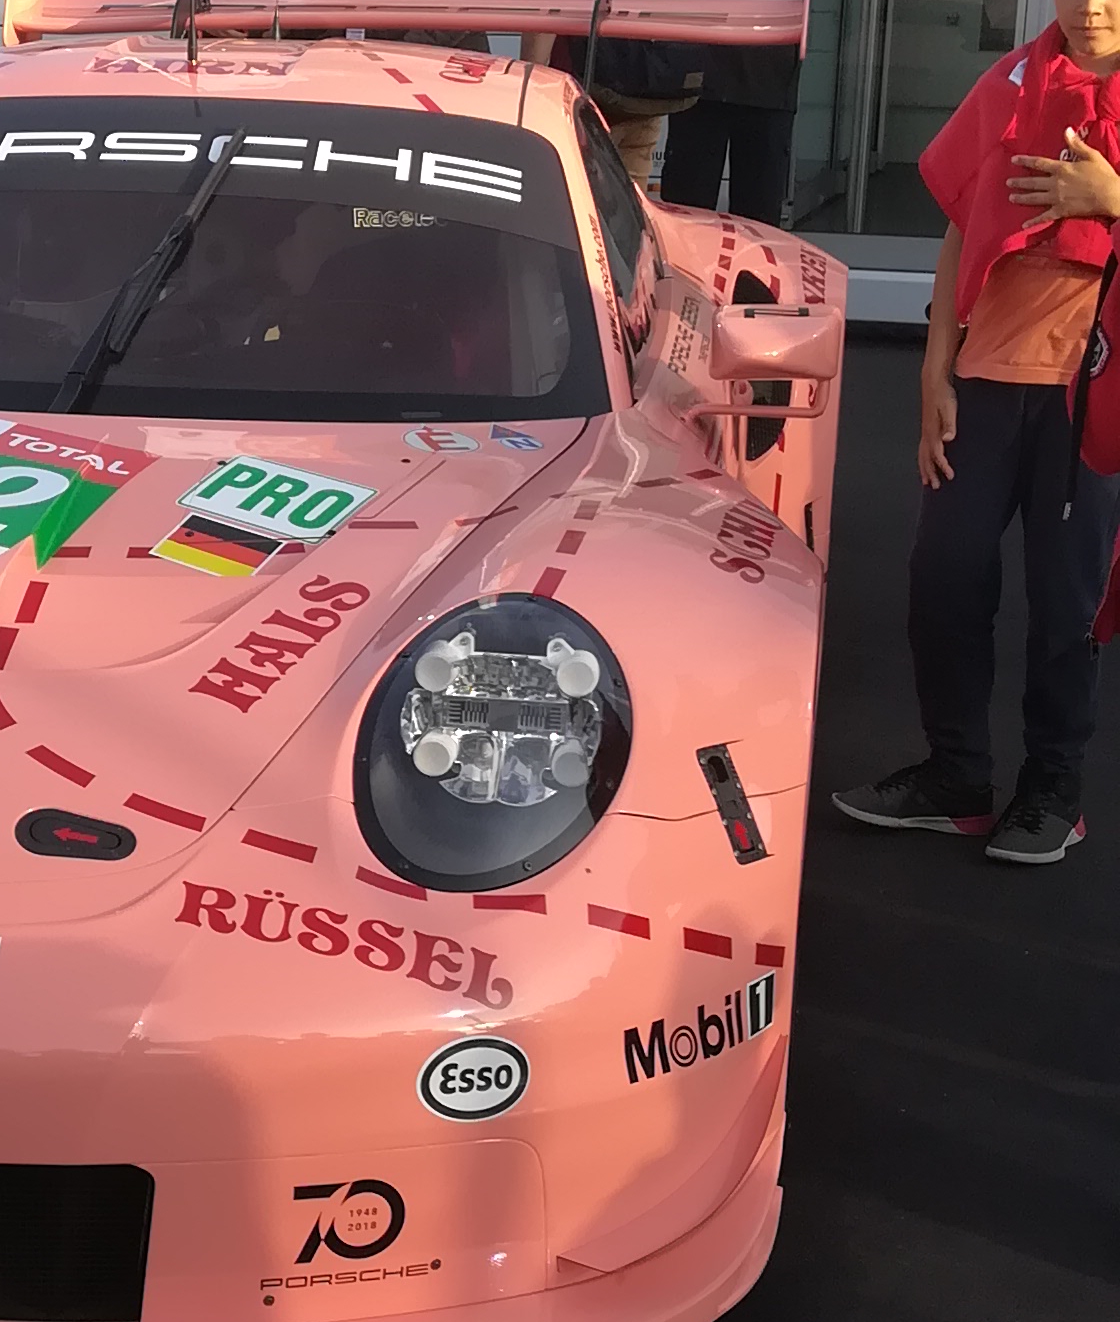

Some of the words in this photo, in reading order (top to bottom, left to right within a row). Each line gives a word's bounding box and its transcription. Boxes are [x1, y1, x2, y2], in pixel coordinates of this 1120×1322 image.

[6, 432, 130, 476] TOTAL
[195, 462, 356, 530] PRO
[189, 573, 372, 713] HALS
[174, 879, 515, 1011] RÜSSEL
[292, 1178, 406, 1265] 70
[347, 1220, 378, 1232] 2018
[348, 1206, 379, 1218] 1948
[259, 1262, 430, 1291] PORSCHE
